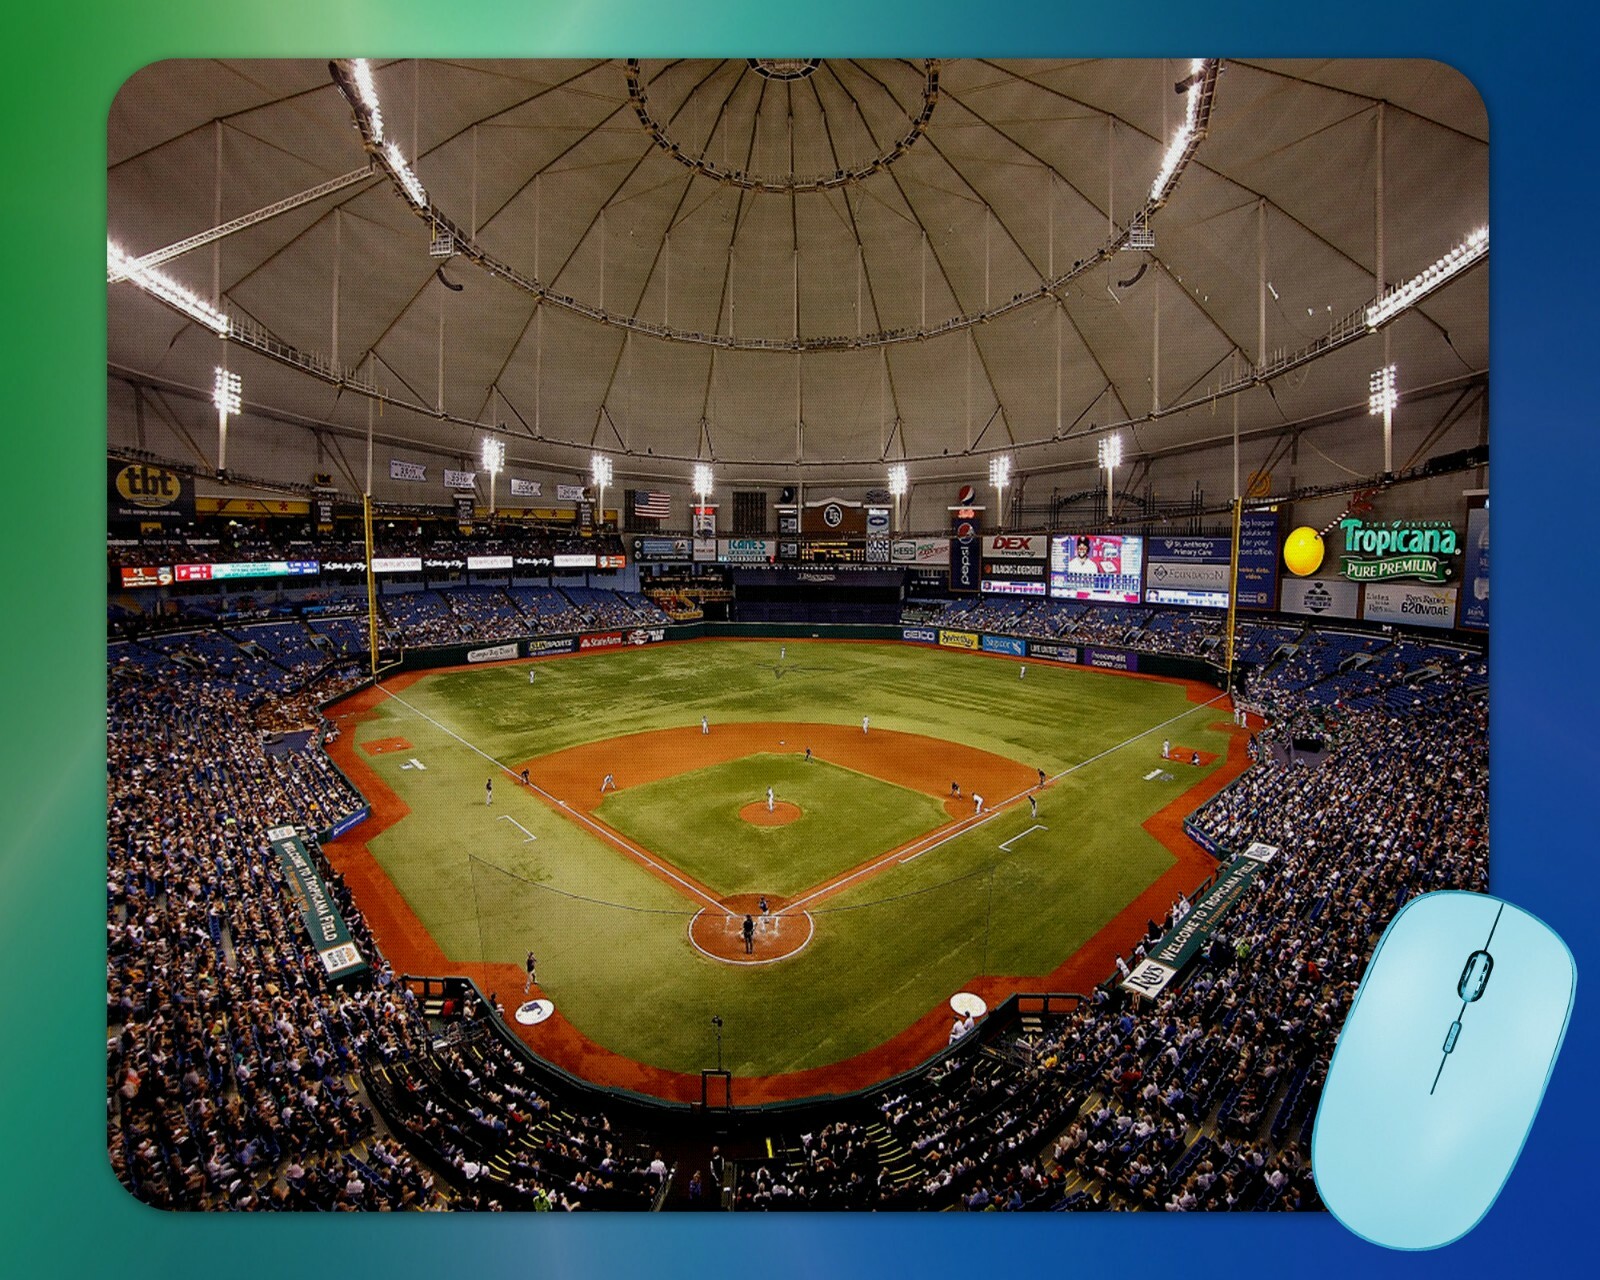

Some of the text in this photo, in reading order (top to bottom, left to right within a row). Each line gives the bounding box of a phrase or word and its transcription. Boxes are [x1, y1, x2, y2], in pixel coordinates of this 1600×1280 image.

[125, 466, 173, 496] tbt
[992, 536, 1032, 550] DEX
[1183, 540, 1214, 549] Anthony's
[1340, 518, 1457, 557] Tropicana
[893, 546, 915, 556] HESS
[1174, 548, 1212, 557] Primary Care
[960, 546, 971, 585] pepsi
[1347, 560, 1437, 577] PURE PREMIUM
[903, 630, 935, 641] GEICO
[1091, 659, 1127, 669] score.com
[280, 841, 306, 868] WELCOME
[300, 865, 311, 877] TO
[303, 874, 331, 917] TROPICANA
[1199, 876, 1243, 910] TROPICANA
[1191, 910, 1208, 921] TO
[319, 914, 338, 942] FIELD
[1158, 920, 1201, 962] WELCOME
[1128, 964, 1165, 991] RAYS
